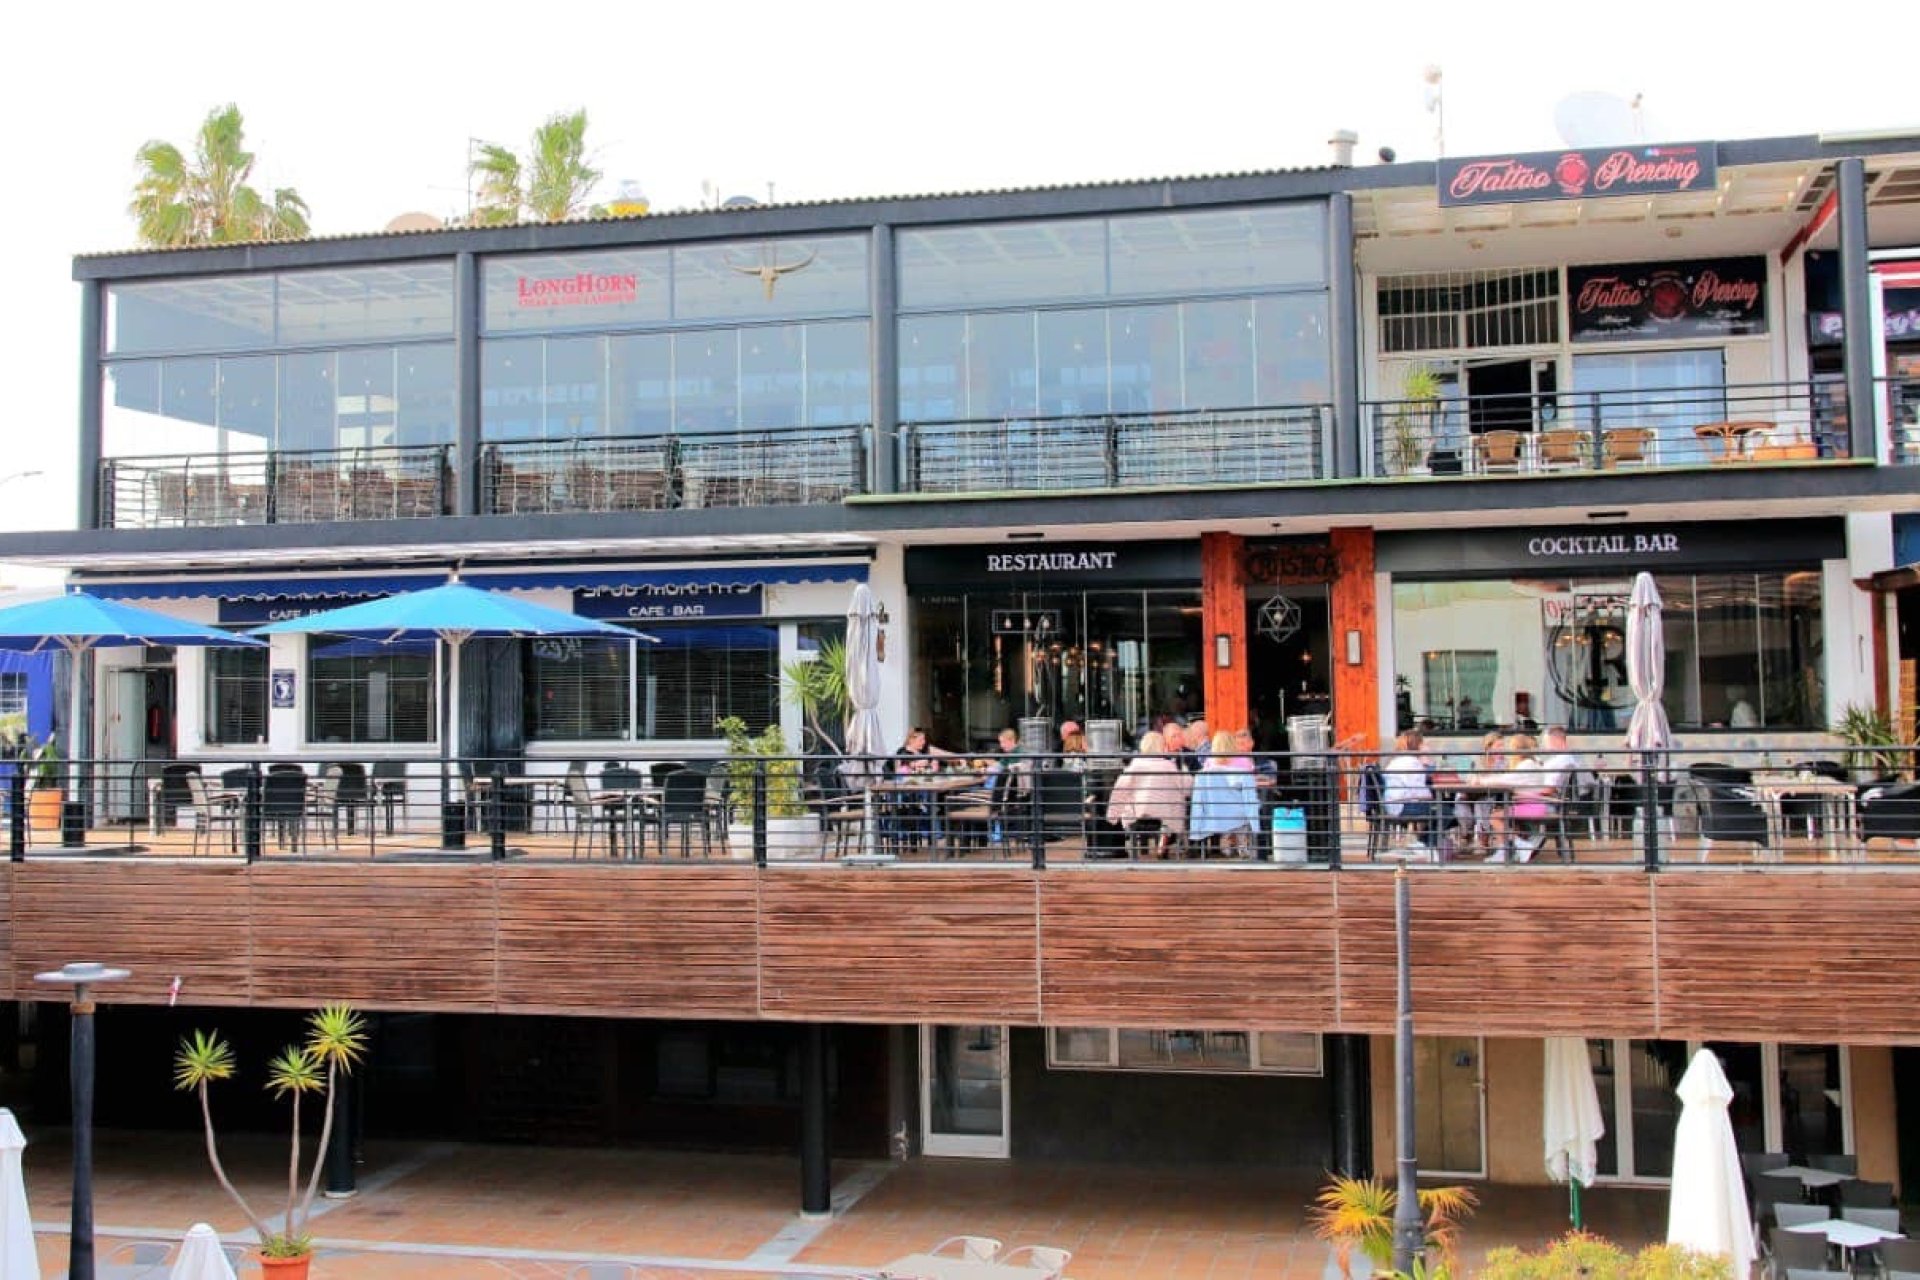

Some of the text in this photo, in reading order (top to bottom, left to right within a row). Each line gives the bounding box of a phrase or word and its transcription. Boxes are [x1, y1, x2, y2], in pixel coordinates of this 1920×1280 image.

[1451, 151, 1699, 198] Tattoo Piercing
[1577, 270, 1760, 314] Tattoo Piercing
[1528, 533, 1681, 556] COCKTAIL BAR
[987, 552, 1117, 572] RESTAURANT
[628, 605, 705, 617] CAFE BAR
